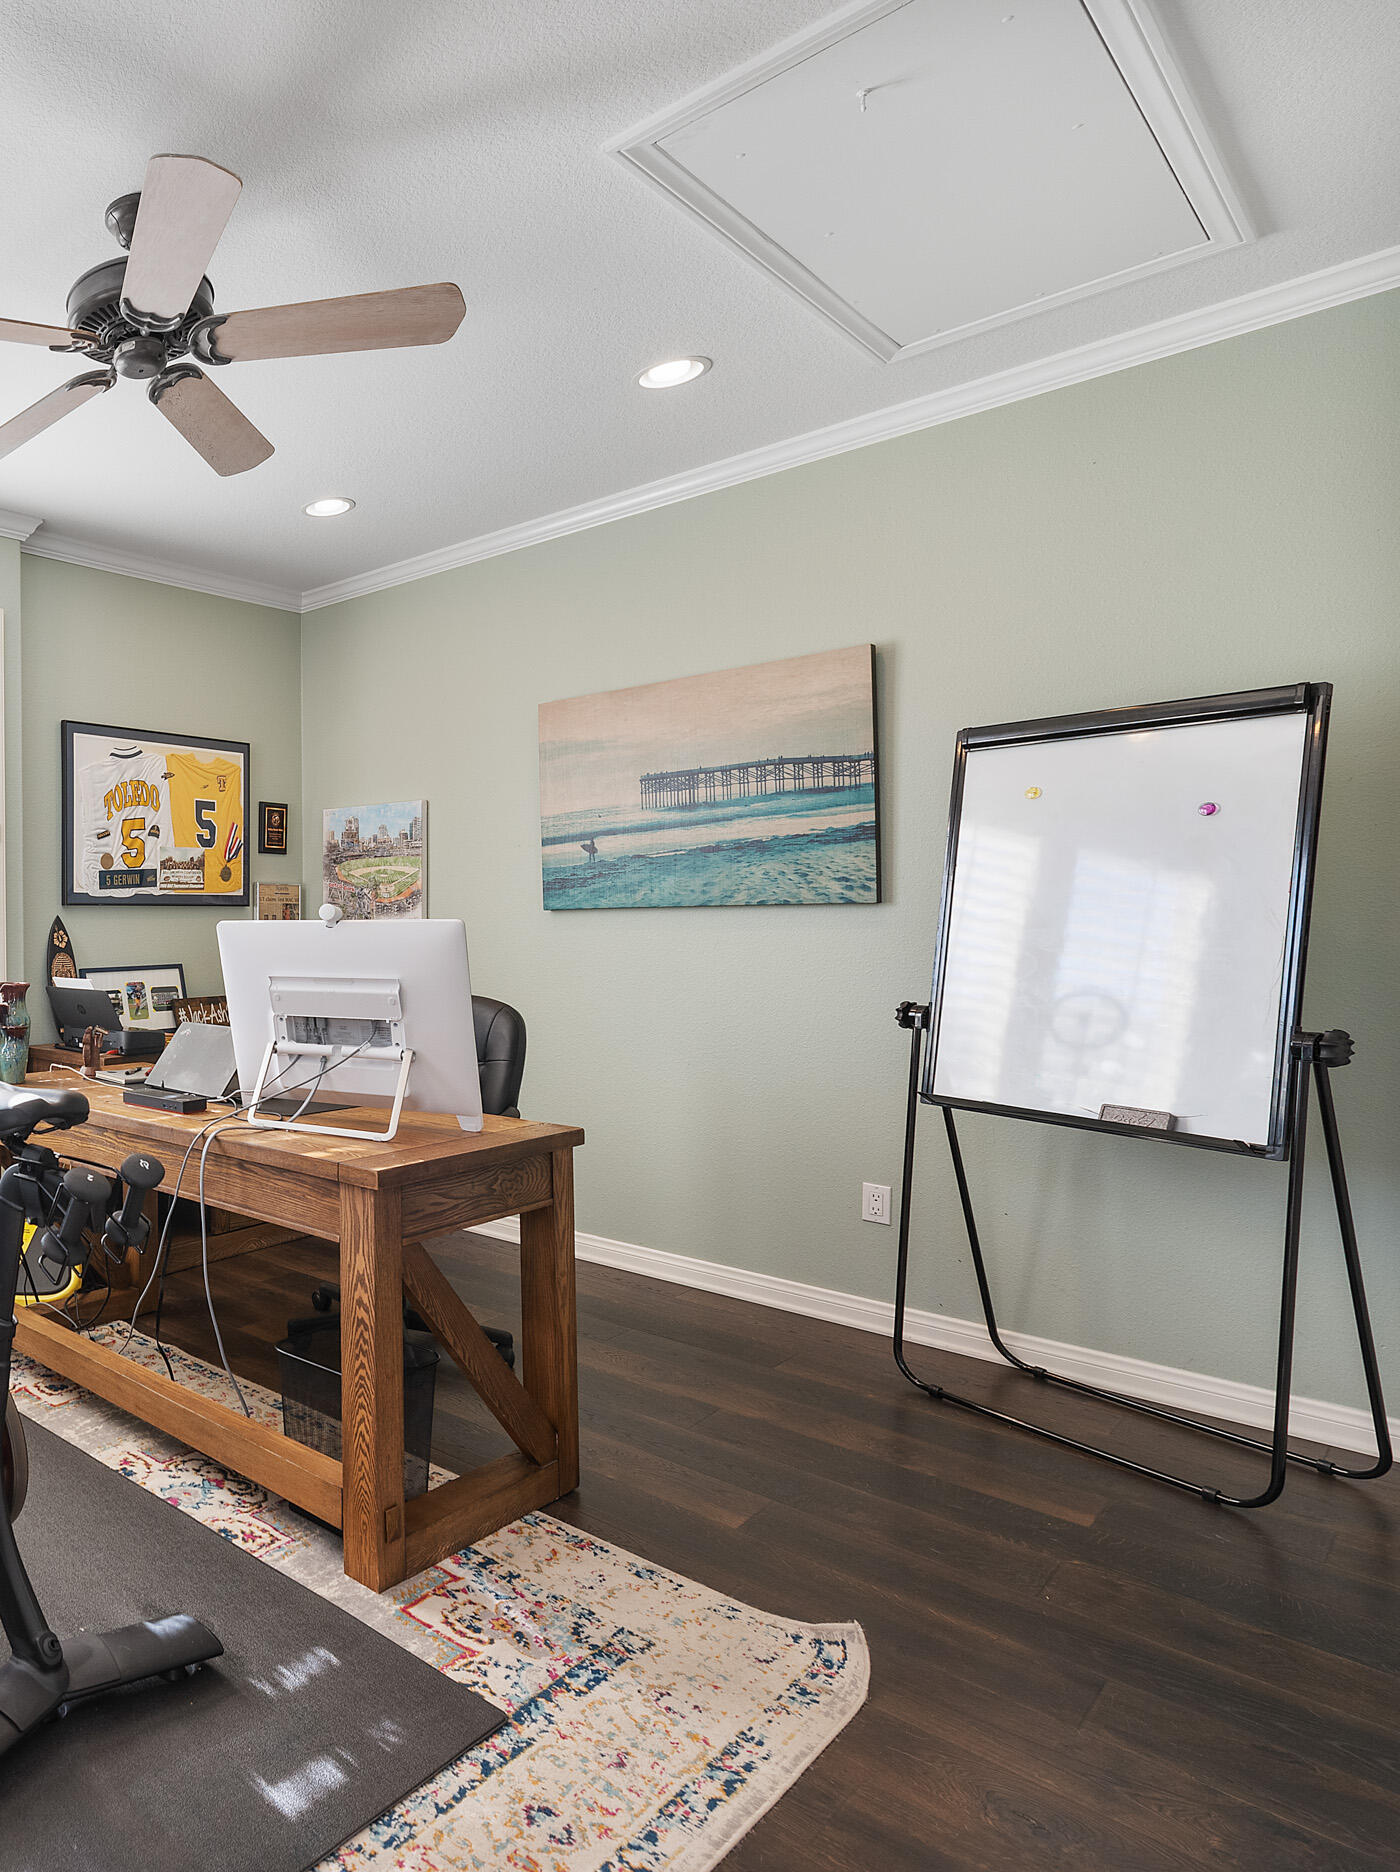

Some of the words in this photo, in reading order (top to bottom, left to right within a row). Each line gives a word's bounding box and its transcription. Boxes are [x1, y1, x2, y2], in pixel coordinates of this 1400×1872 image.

[103, 780, 161, 821] TOLEDO
[194, 798, 217, 849] 5
[120, 817, 146, 868] 5
[105, 875, 111, 886] 5
[113, 873, 141, 886] GERWIN
